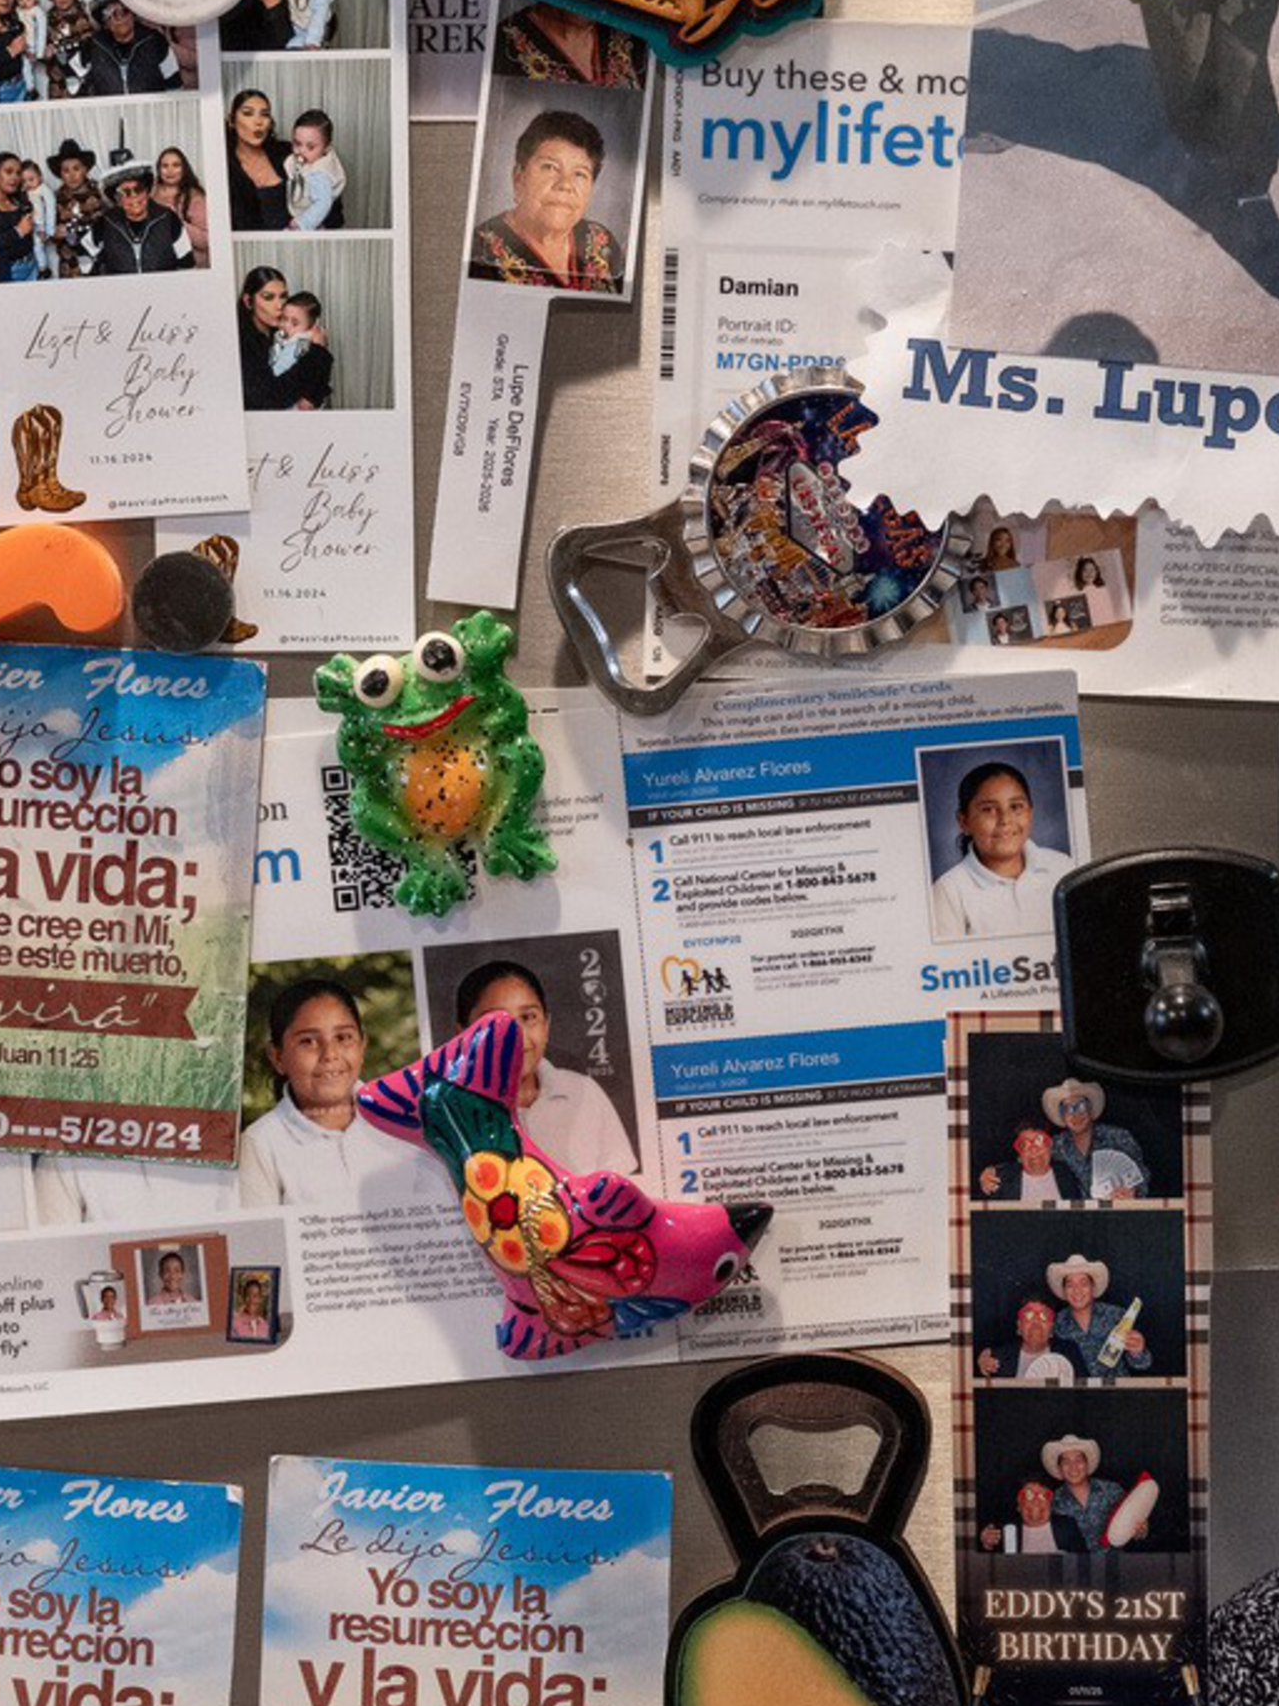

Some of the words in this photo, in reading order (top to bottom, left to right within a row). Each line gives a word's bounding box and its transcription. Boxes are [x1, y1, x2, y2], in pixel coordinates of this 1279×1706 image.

[701, 58, 768, 98] Buy
[775, 62, 868, 94] these
[879, 63, 903, 94] &
[718, 275, 800, 297] Damian
[93, 320, 112, 345] &
[123, 353, 201, 399] Baby
[512, 362, 529, 408] Lupe
[902, 338, 1064, 415] Ms.
[104, 388, 202, 439] Shower
[500, 410, 525, 488] DeFlores
[694, 763, 756, 782] Alvarez
[760, 759, 812, 777] Flores
[20, 1296, 55, 1316] plus
[314, 1471, 447, 1518] Javier
[484, 1478, 614, 1525] Flores
[367, 1567, 419, 1609] Yo
[428, 1576, 502, 1621] soy
[511, 1576, 547, 1614] la
[984, 1590, 1105, 1621] EDDY'S
[1114, 1591, 1186, 1621] 21ST
[329, 1611, 584, 1654] resurrección
[998, 1632, 1174, 1662] BIRTHDAY
